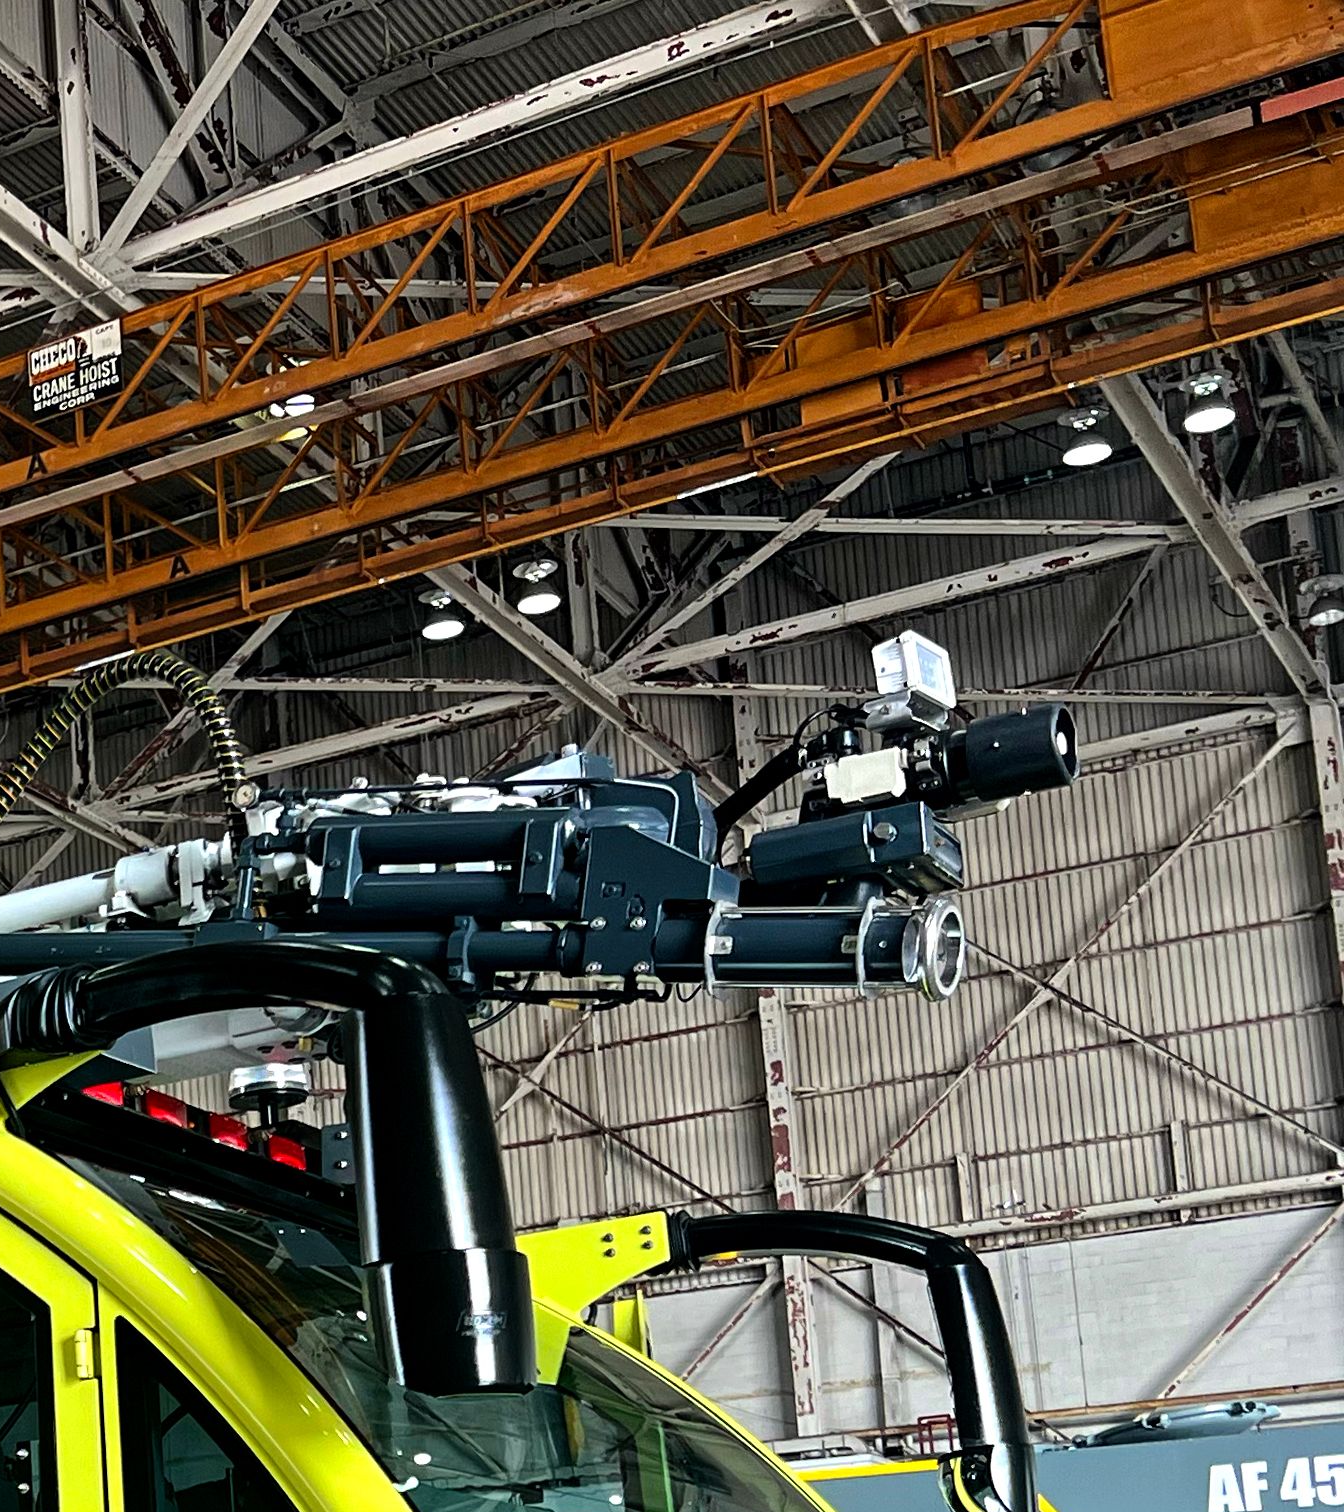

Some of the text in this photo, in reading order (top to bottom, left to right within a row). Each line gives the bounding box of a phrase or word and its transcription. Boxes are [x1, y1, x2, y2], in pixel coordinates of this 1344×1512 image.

[31, 339, 75, 375] CHECO
[33, 371, 75, 402] CRANE
[79, 357, 119, 386] HOIST
[33, 374, 120, 412] ENGINEERING
[27, 454, 48, 481] A
[169, 555, 190, 579] A
